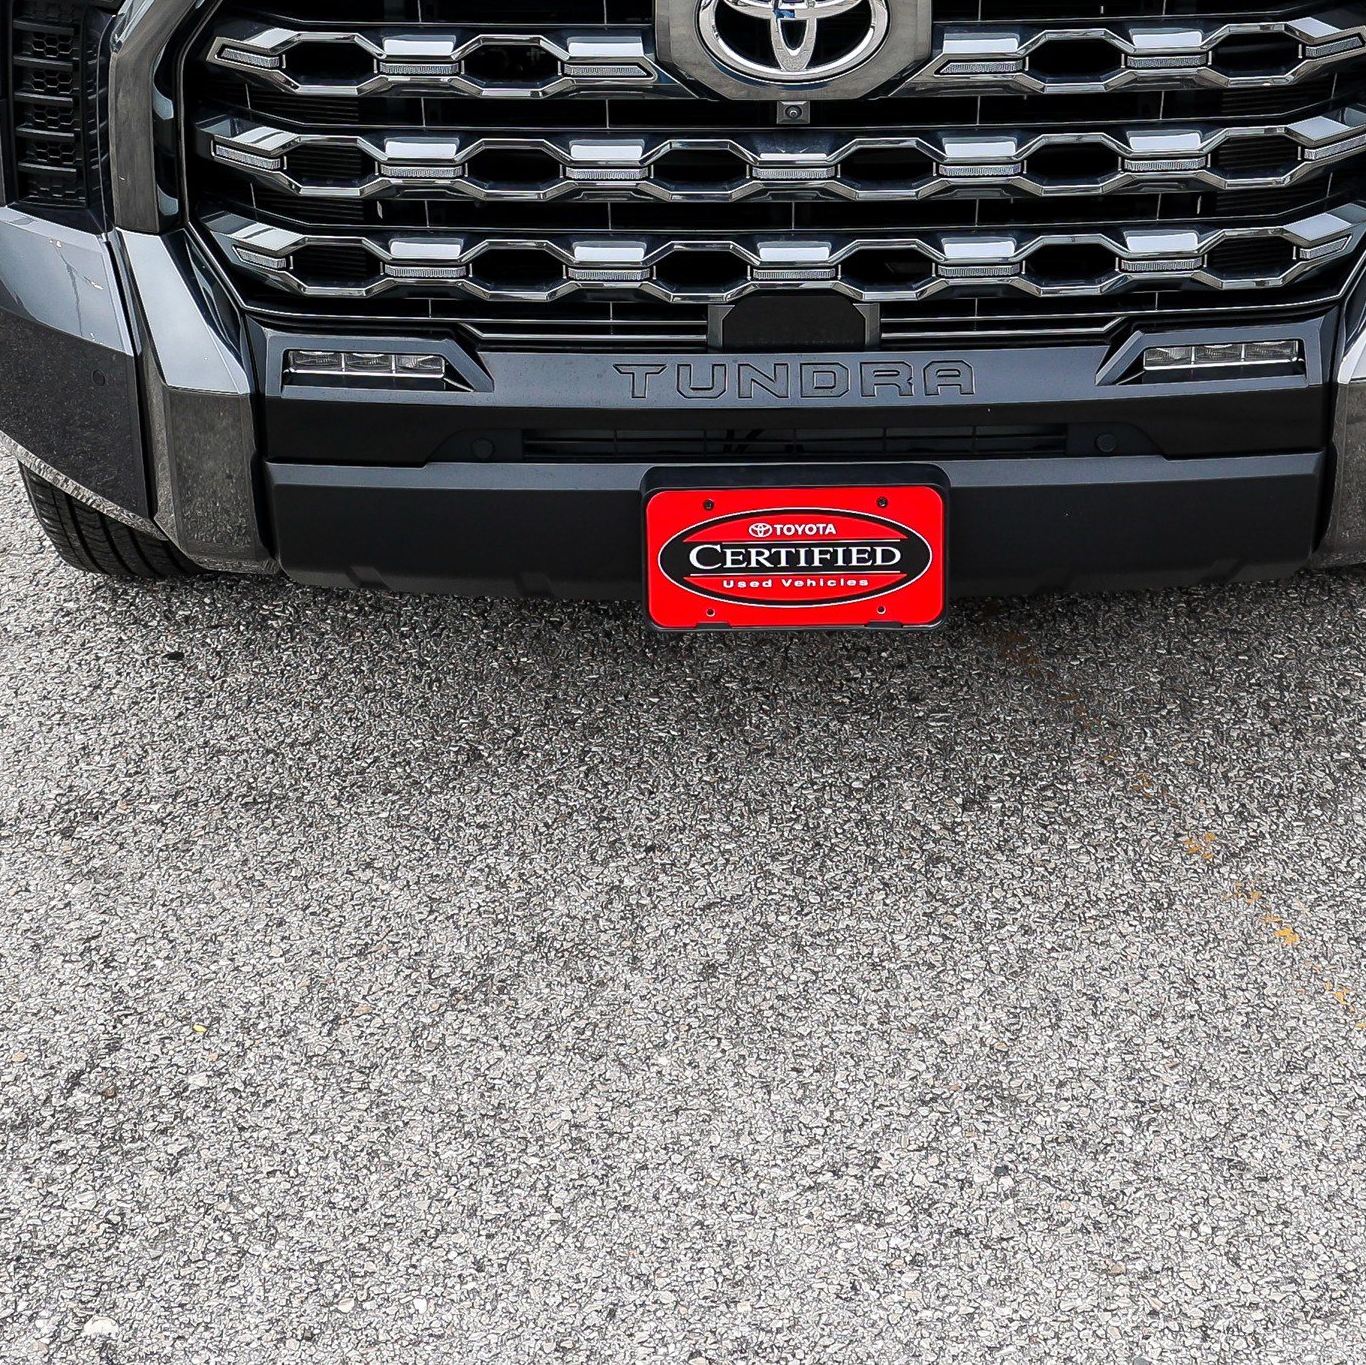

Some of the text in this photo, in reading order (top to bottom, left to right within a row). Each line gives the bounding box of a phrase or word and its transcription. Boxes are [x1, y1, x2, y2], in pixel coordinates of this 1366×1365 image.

[612, 359, 976, 400] TUNDRA
[774, 522, 837, 536] TOYOTA
[689, 545, 901, 570] CERTIFIED
[722, 577, 869, 589] Used Vehicles
